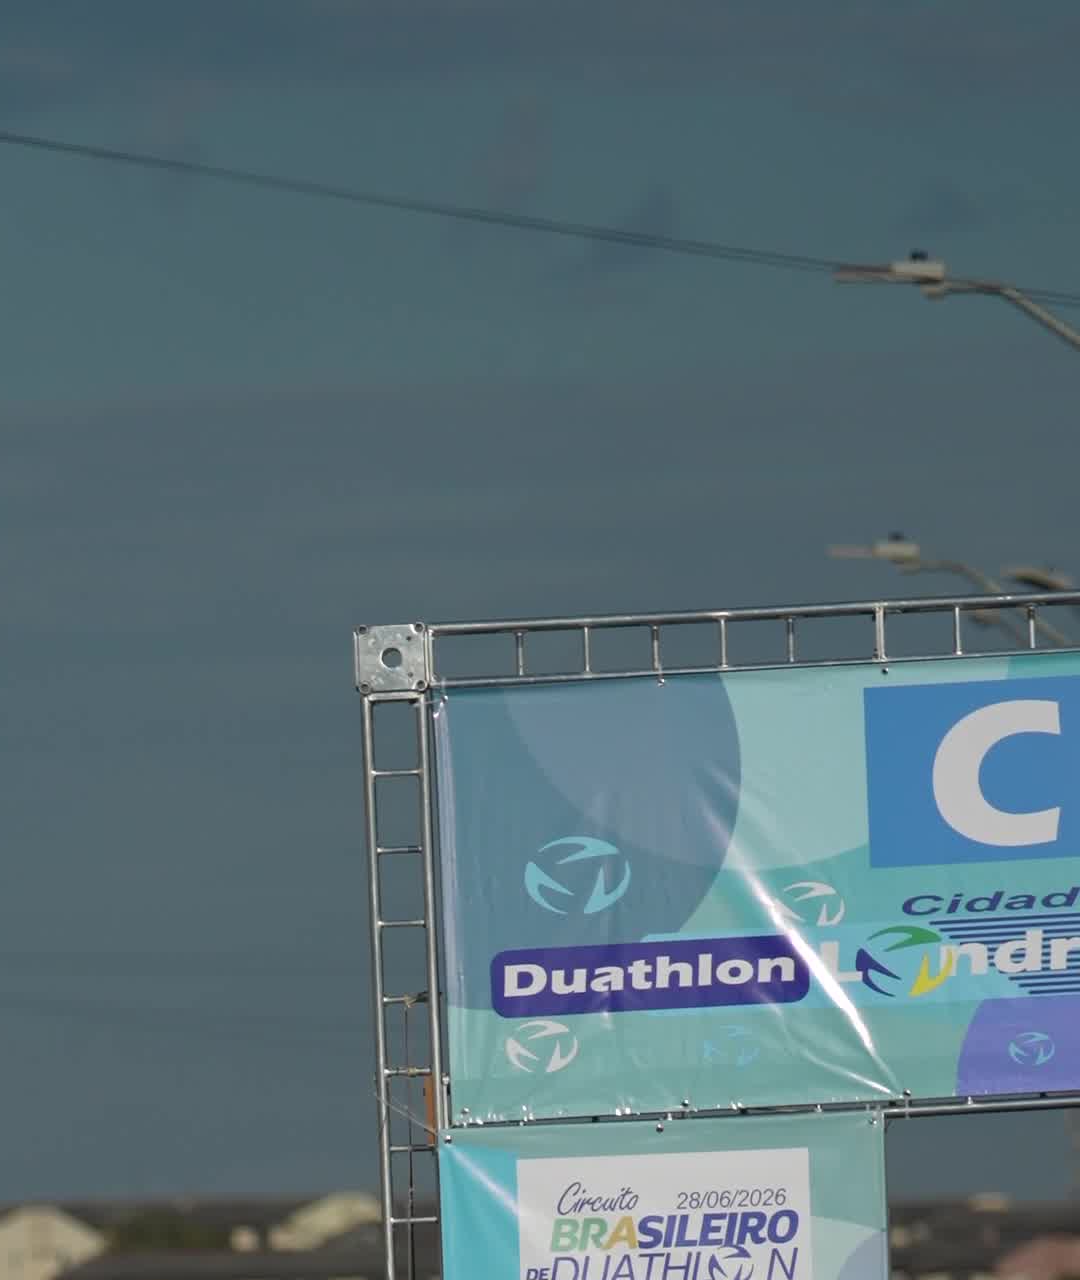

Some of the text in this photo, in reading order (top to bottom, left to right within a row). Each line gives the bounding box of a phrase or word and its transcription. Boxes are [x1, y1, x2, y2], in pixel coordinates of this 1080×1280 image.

[902, 887, 1080, 915] Cidad
[503, 952, 795, 999] Duathlon
[557, 1182, 787, 1216] Circuito 28/06/2026
[551, 1209, 799, 1251] BRASILEIRO
